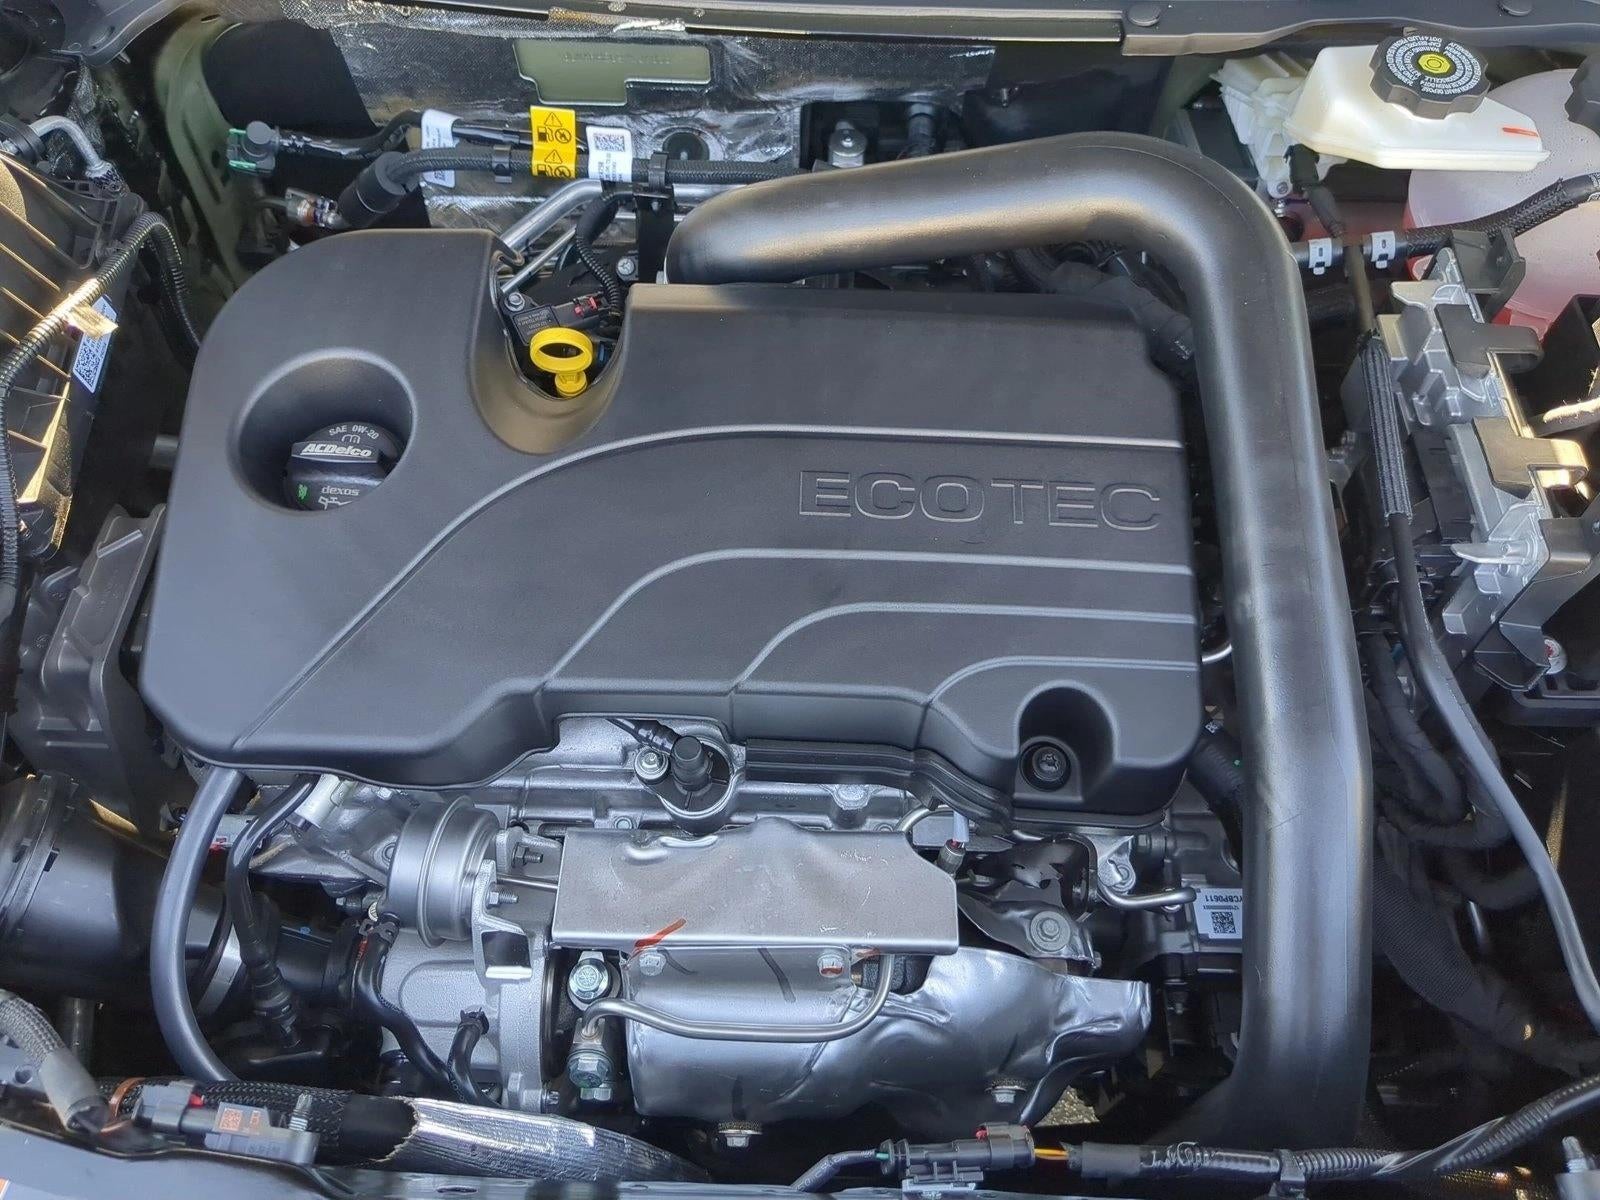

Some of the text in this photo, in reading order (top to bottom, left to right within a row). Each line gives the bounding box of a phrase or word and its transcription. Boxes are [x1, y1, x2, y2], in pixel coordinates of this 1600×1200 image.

[329, 424, 379, 440] SAE 0W-20
[300, 443, 372, 457] ACDelco
[321, 485, 360, 496] dexos
[799, 470, 1161, 531] ECOTEC
